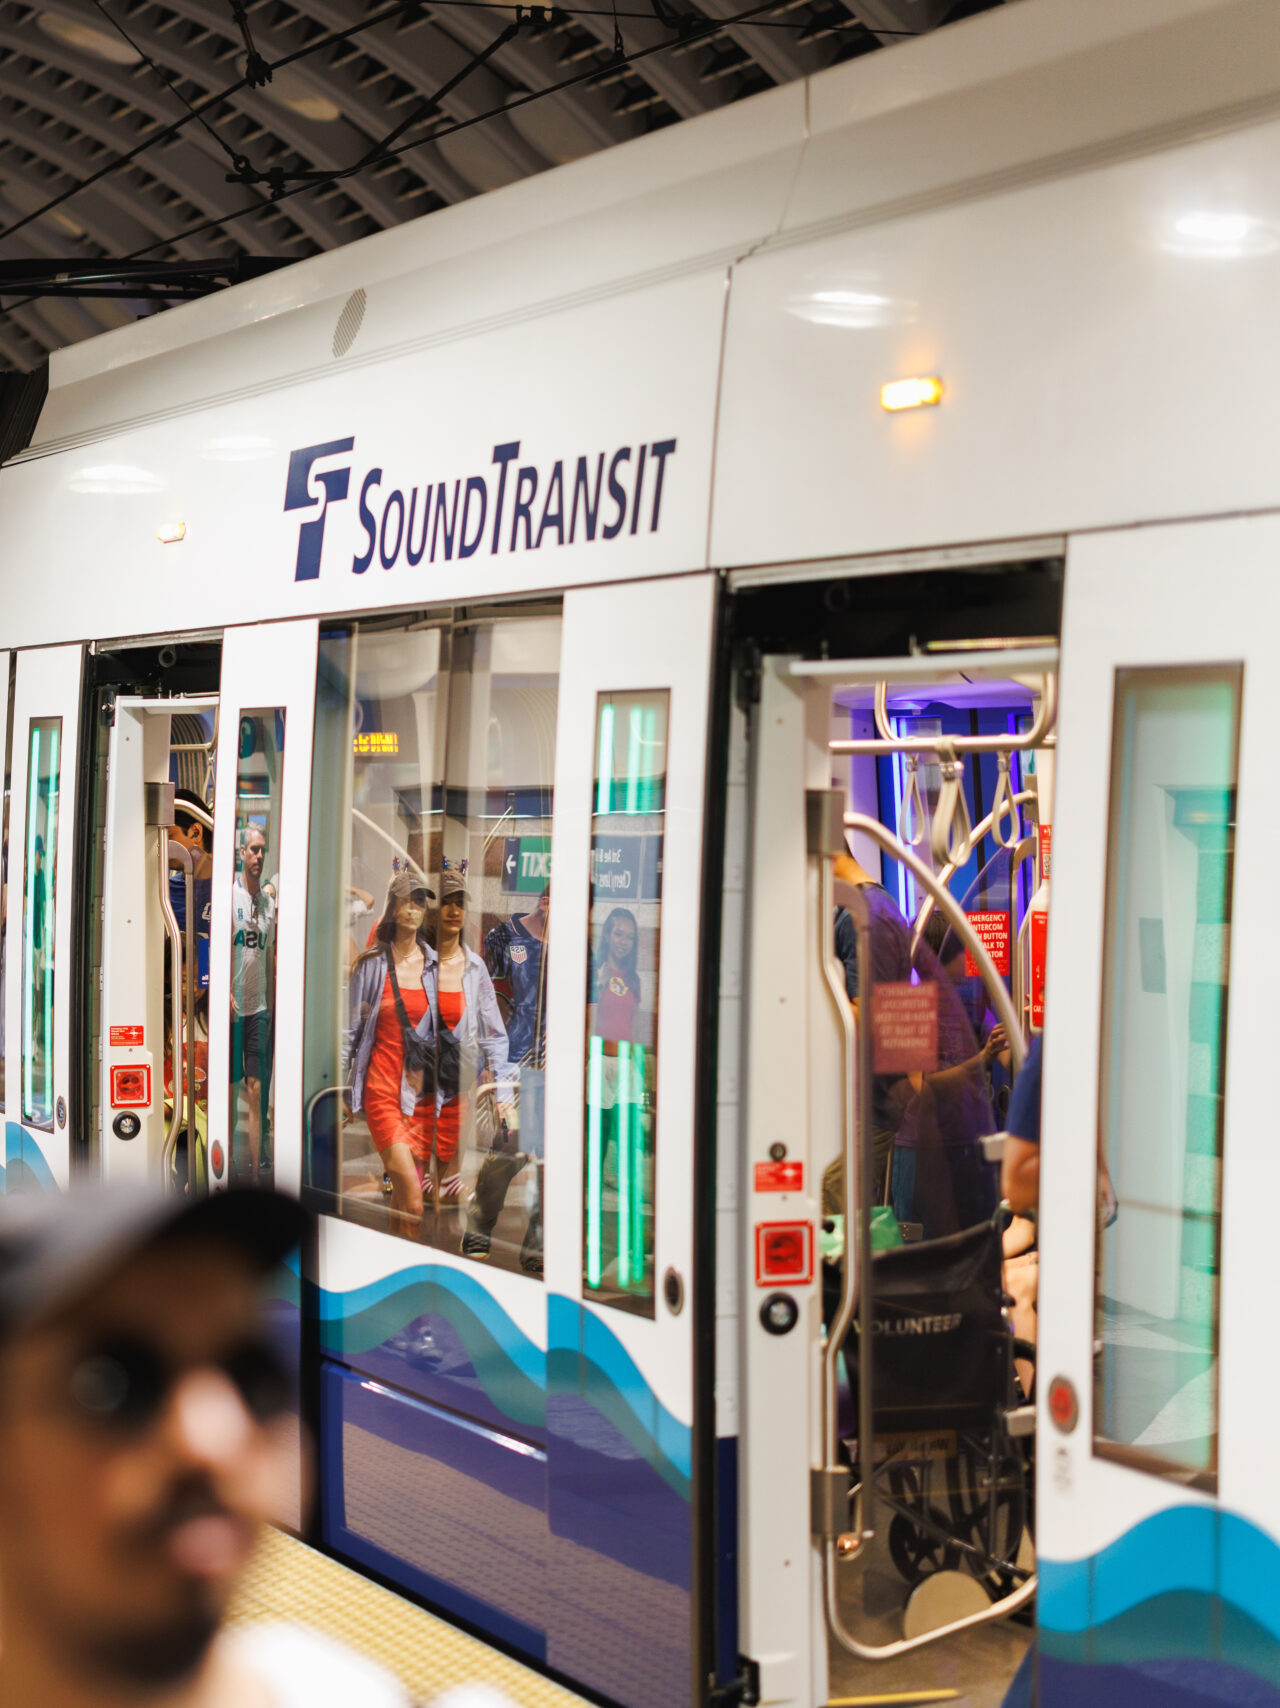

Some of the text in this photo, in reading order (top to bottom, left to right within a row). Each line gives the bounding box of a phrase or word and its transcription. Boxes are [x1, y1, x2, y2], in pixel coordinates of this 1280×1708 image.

[968, 914, 1006, 922] EMERGENCY
[972, 923, 1003, 931] NTERCOM
[983, 932, 1008, 940] BUTTON
[983, 941, 1005, 949] ALK TO
